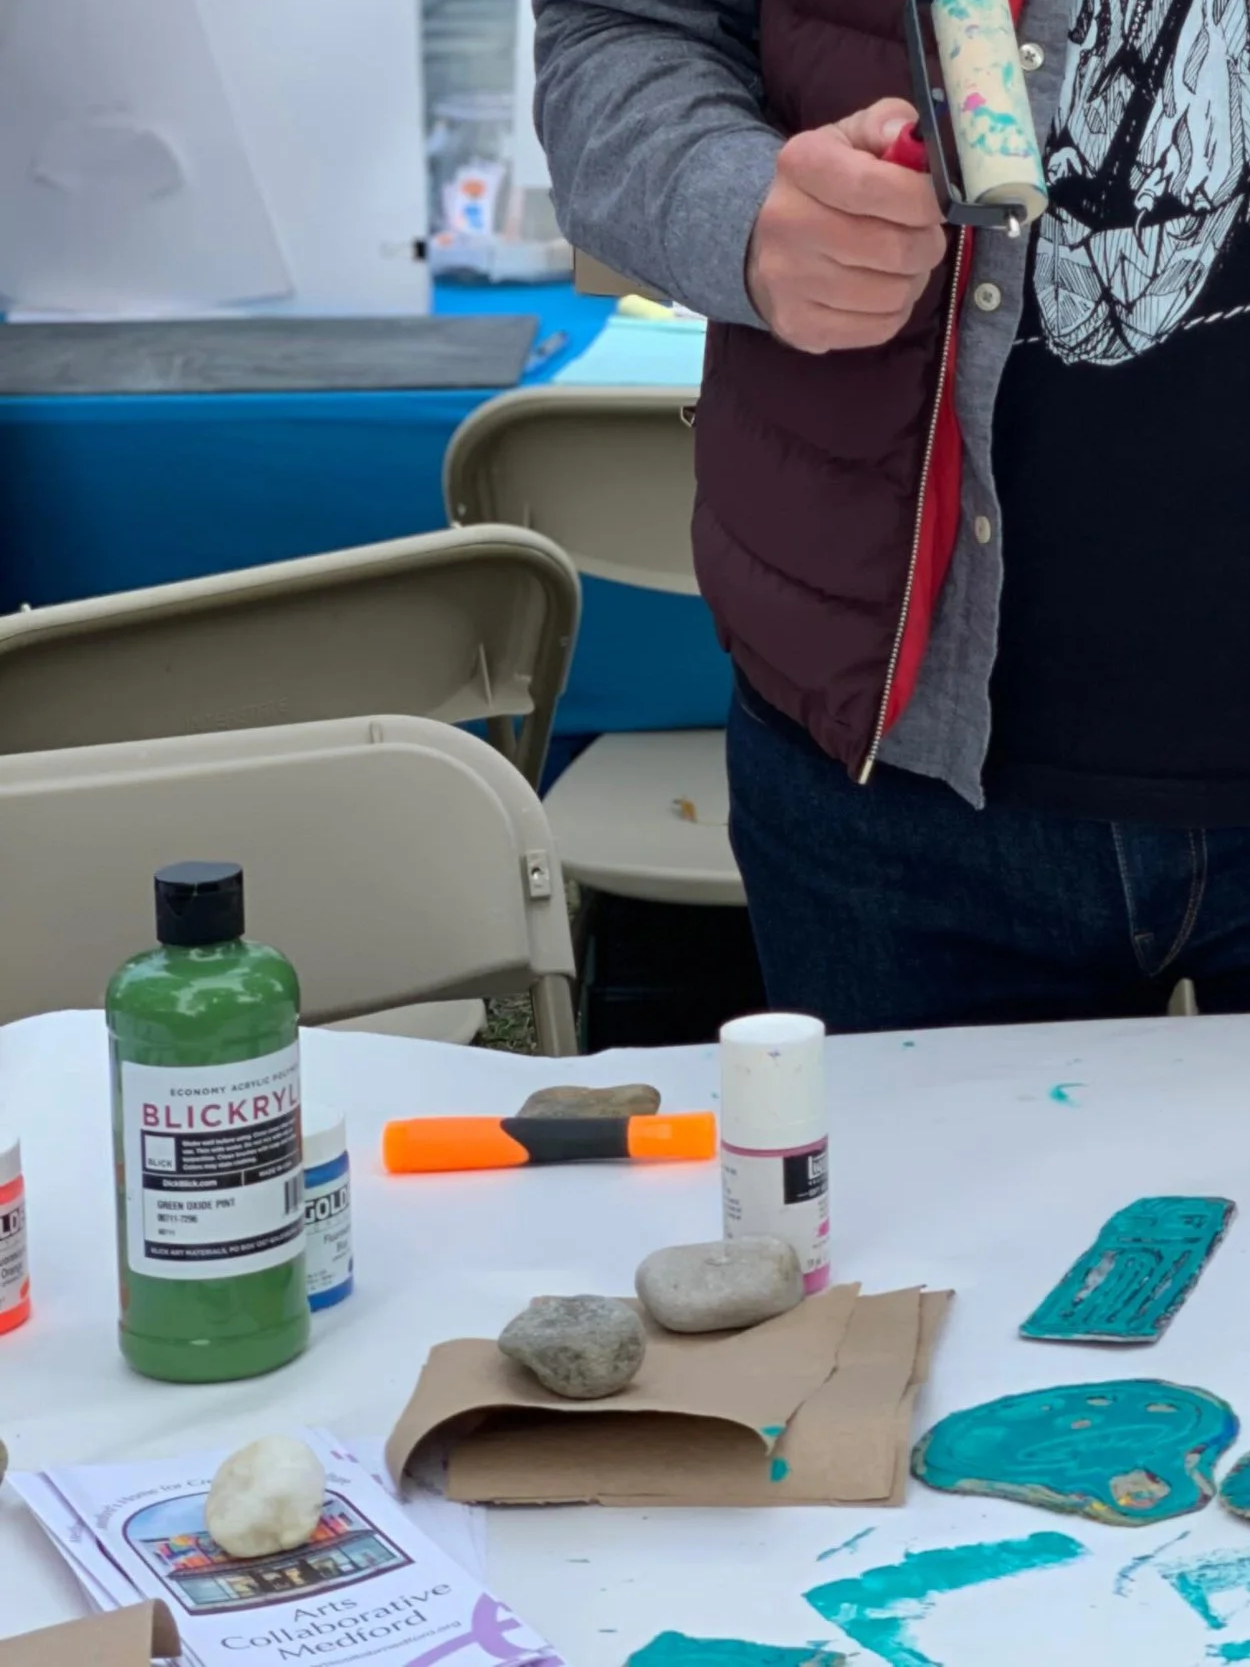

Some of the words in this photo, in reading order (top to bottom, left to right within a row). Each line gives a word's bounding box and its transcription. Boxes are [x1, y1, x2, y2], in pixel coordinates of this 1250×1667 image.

[170, 1086, 226, 1097] ECONOMY
[231, 1076, 270, 1092] ACRYLIC
[142, 1083, 298, 1129] BLICKRYL
[148, 1157, 172, 1168] BLICK
[157, 1200, 184, 1211] GREEN
[186, 1200, 212, 1211] OXIDE
[215, 1197, 235, 1209] PINT
[220, 1582, 453, 1651] Collaborative
[292, 1597, 358, 1623] Arts
[277, 1609, 429, 1662] Medford
